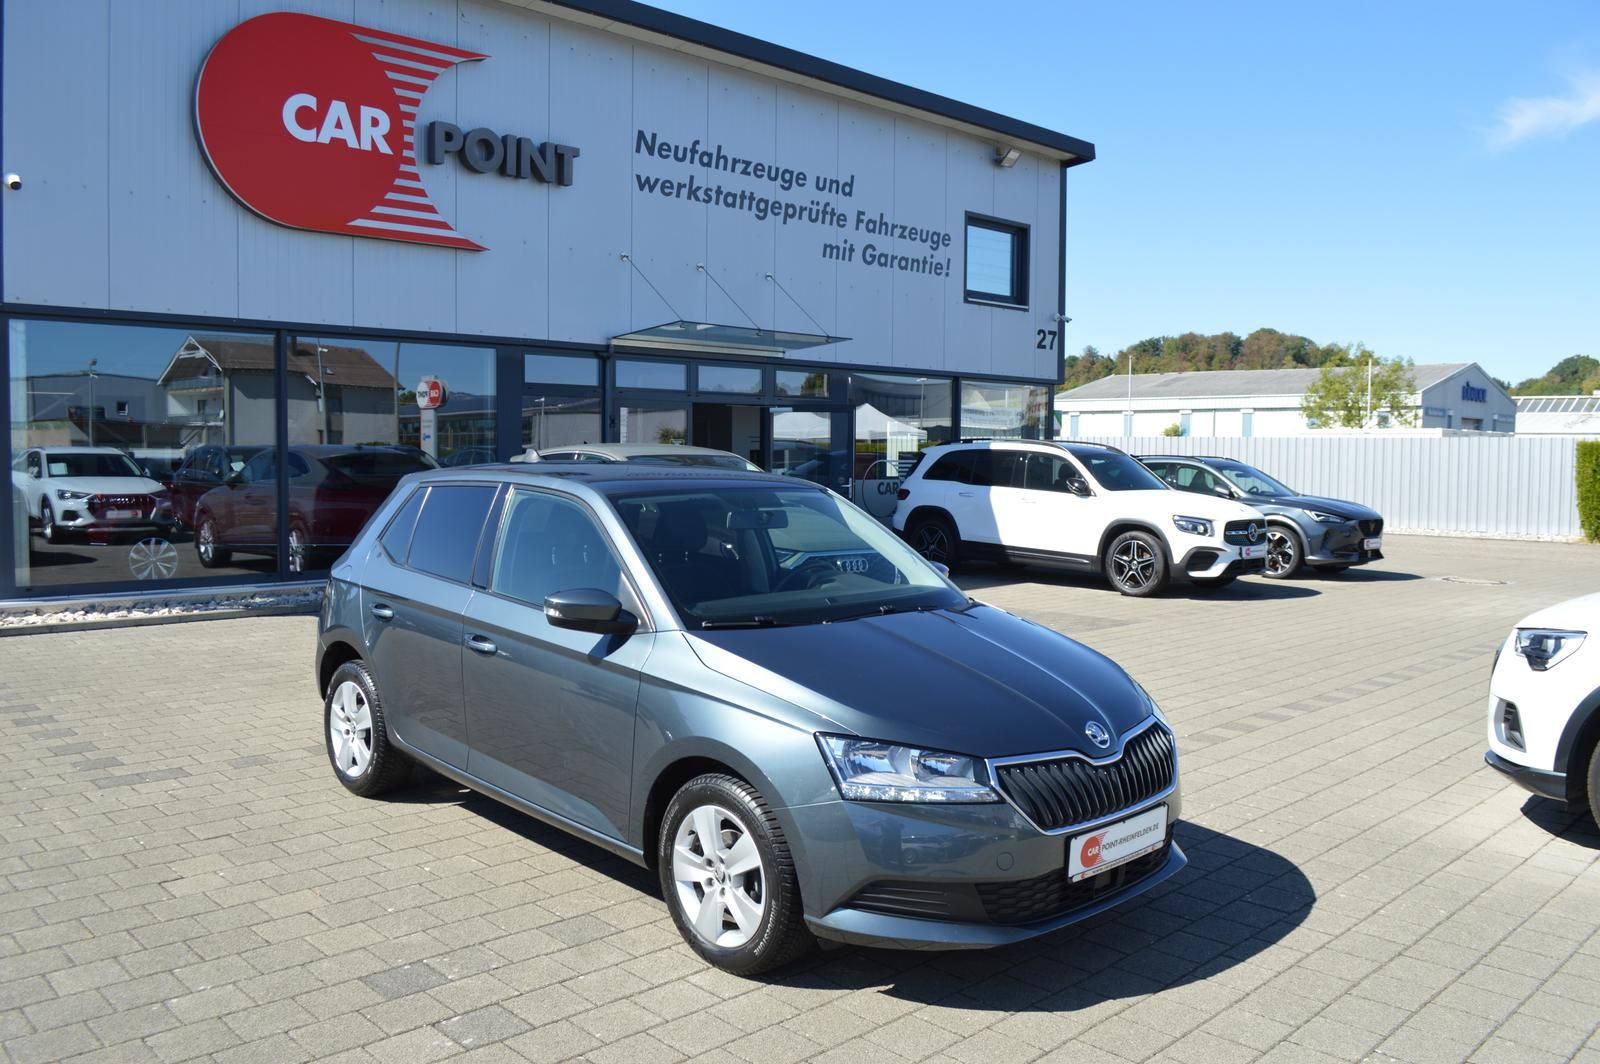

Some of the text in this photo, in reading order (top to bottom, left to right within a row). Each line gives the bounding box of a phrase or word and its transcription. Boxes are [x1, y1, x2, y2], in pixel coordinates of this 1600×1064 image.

[282, 92, 580, 186] CAR POINT
[635, 129, 855, 197] Neufahrzeuge und
[635, 174, 952, 251] werkstattgeprüfte Fahrzeuge
[822, 238, 952, 277] mit Garantie!
[1036, 329, 1058, 350] 27
[1087, 822, 1160, 857] CAR POINT-RHEINFELDEN.DE
